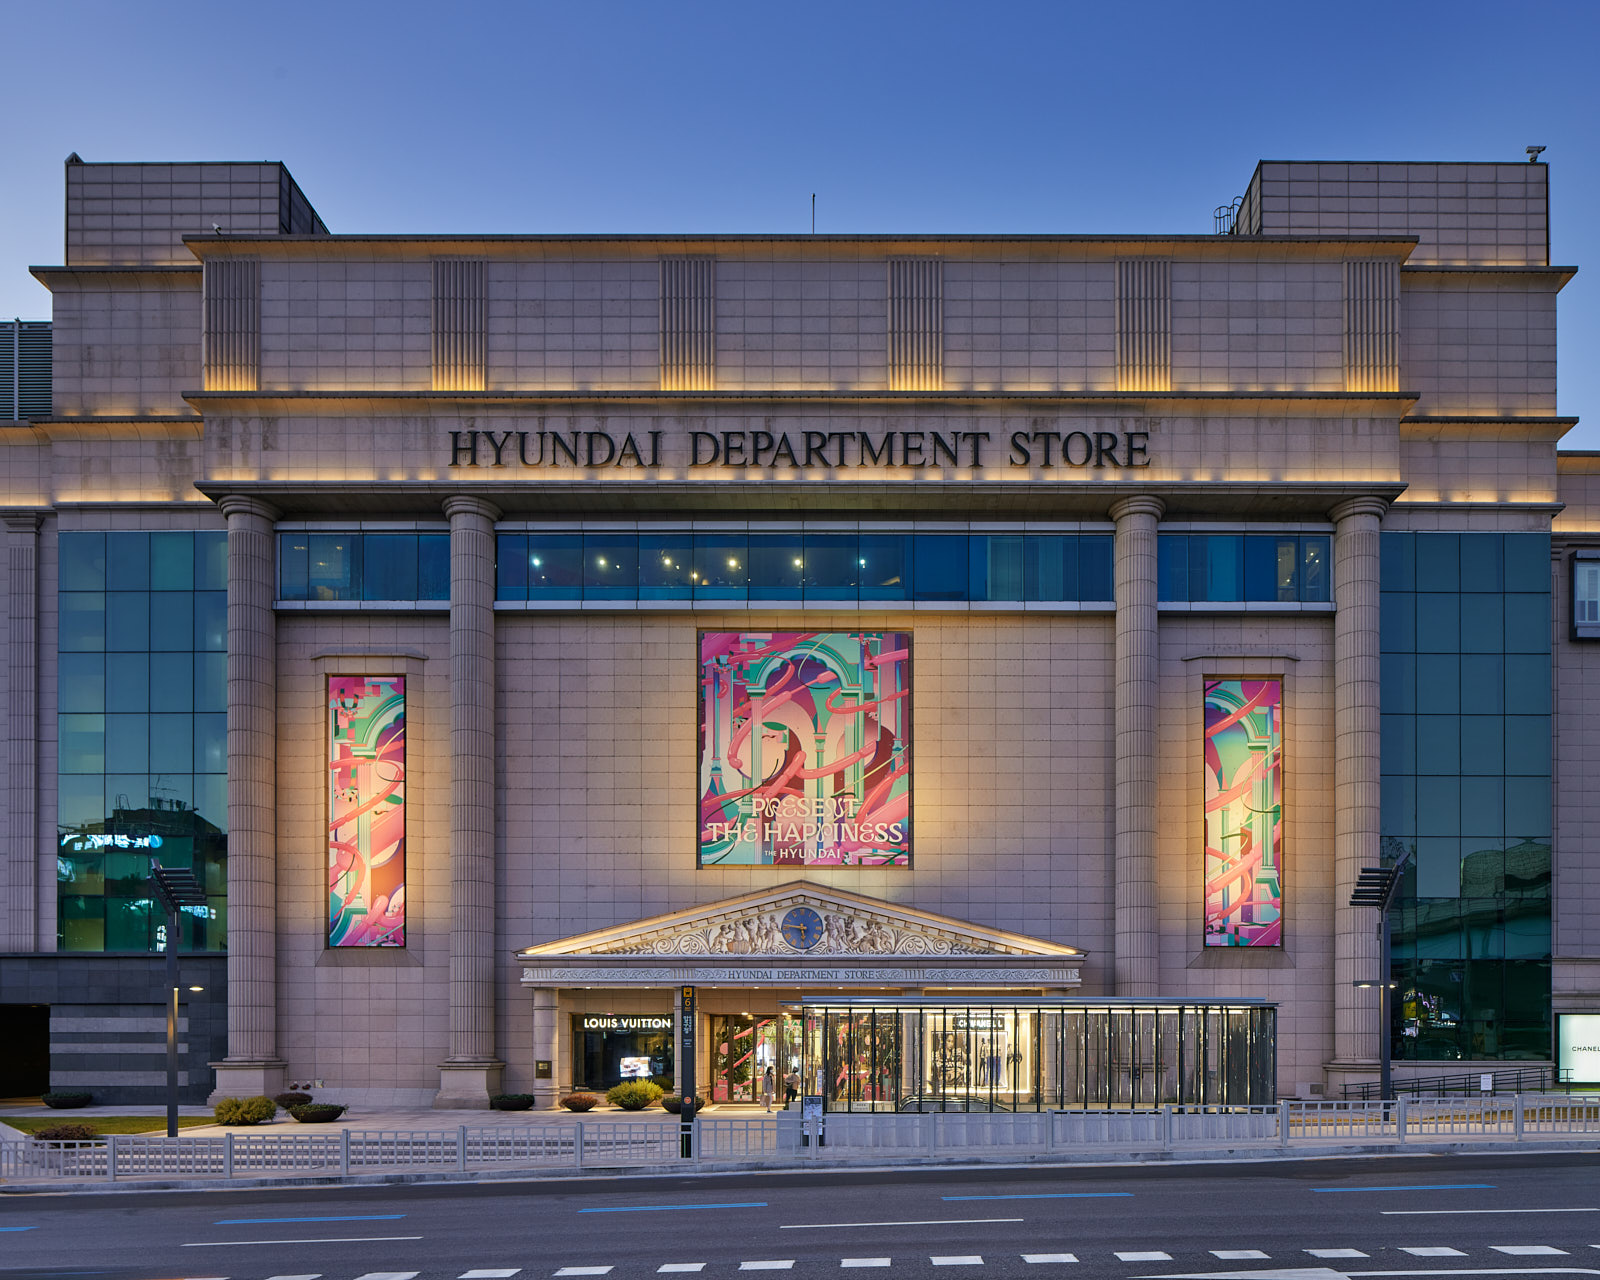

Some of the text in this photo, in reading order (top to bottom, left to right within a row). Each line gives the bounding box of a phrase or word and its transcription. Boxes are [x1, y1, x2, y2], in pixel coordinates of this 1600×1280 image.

[448, 431, 1151, 468] HYUNDAI DEPARTMENT STORE
[751, 797, 859, 818] PRESENT
[706, 822, 903, 843] THE HAPPINESS
[780, 848, 841, 859] HYUNDAI
[728, 970, 874, 980] HYUNDAI DEPARTMENT STORE
[684, 997, 691, 1007] 6
[584, 1018, 618, 1029] LOUIS
[620, 1018, 671, 1029] VUITTON
